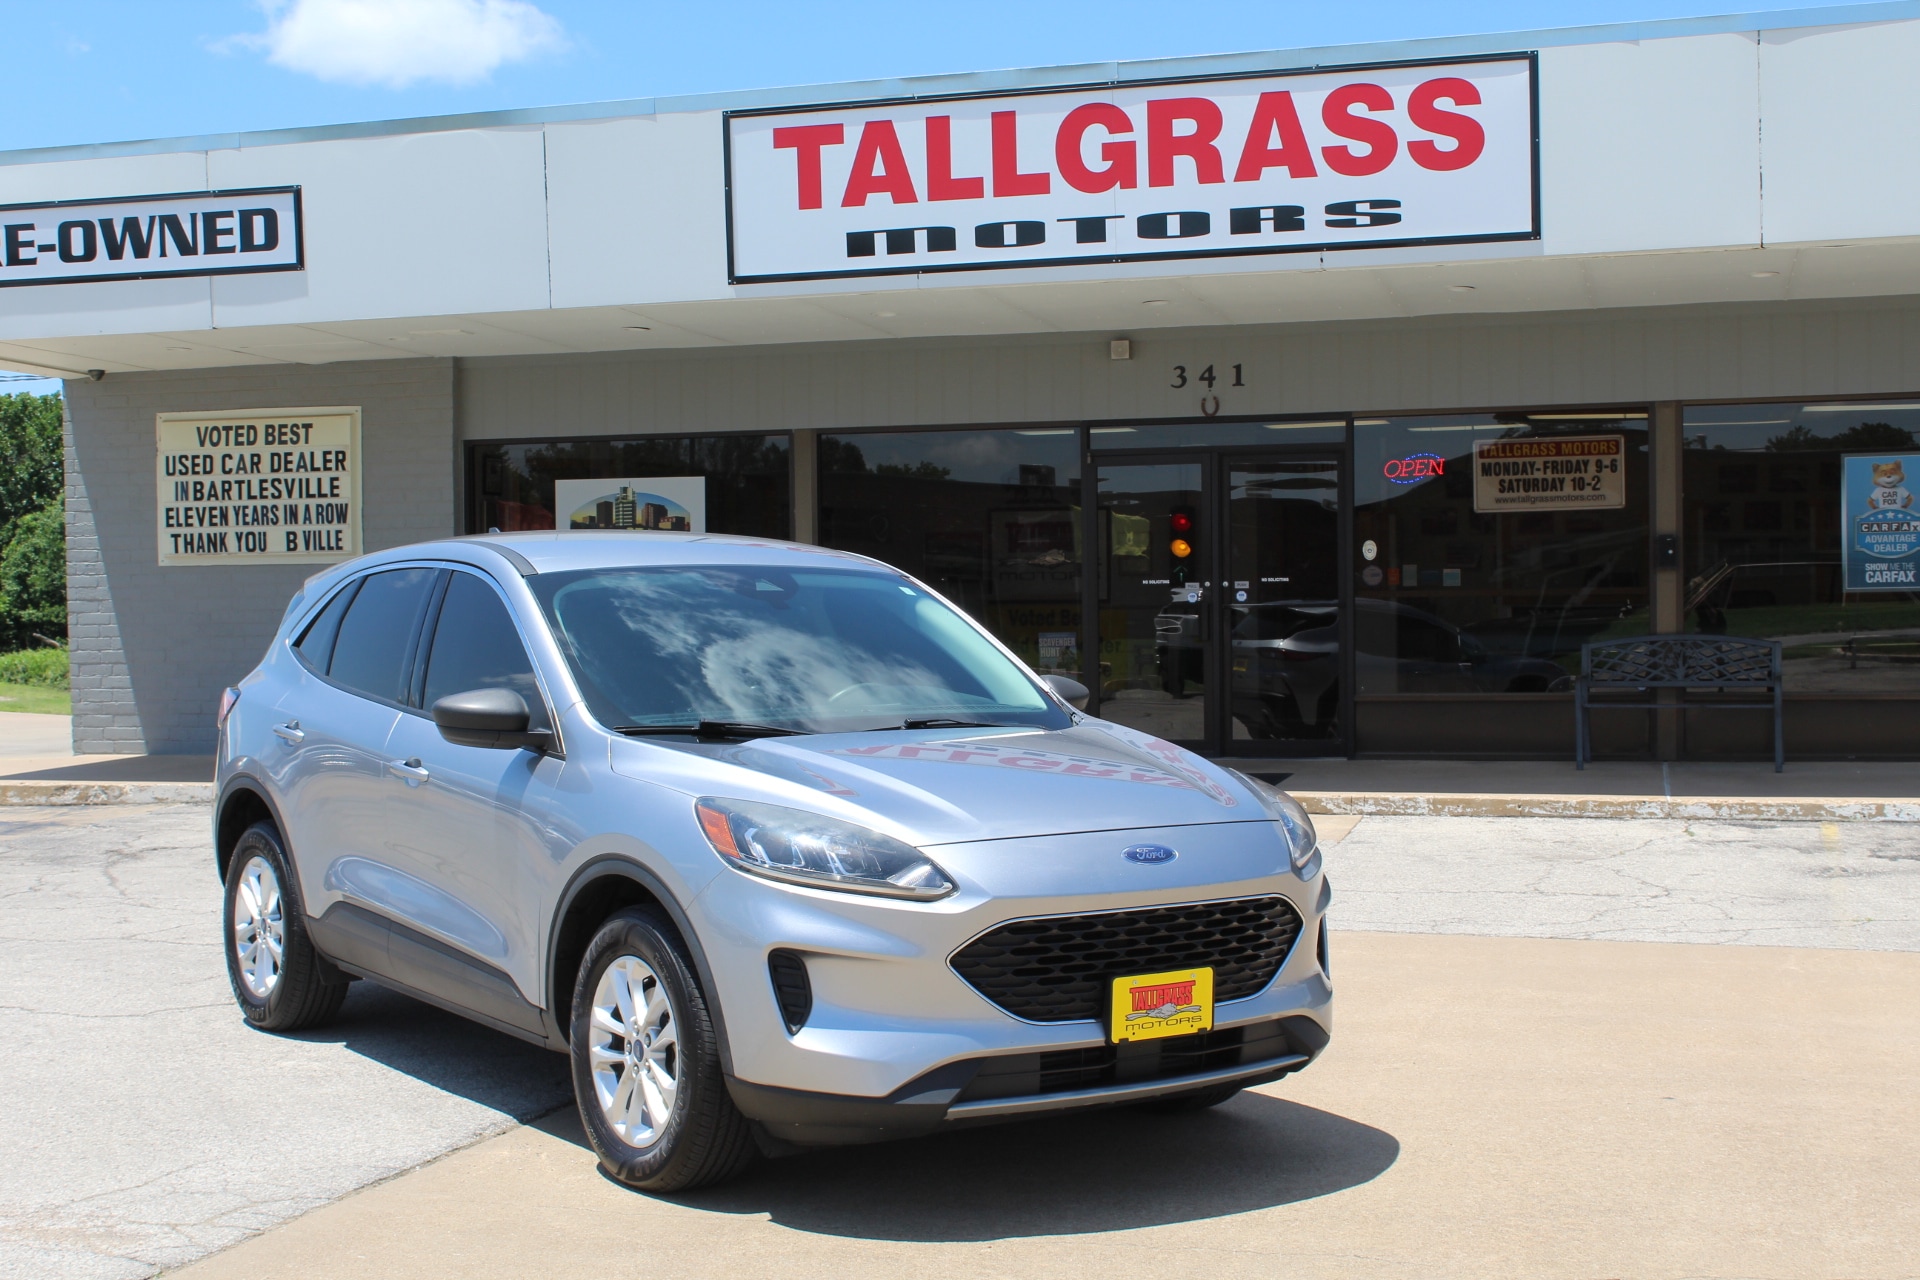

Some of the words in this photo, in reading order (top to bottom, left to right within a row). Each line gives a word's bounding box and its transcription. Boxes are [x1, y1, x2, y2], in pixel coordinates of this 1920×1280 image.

[772, 77, 1485, 211] TALLGRASS
[845, 199, 1402, 258] MOTORS
[0, 208, 279, 267] E-OWNED
[196, 424, 258, 448] VOTED
[264, 422, 313, 446] BEST
[1482, 443, 1557, 457] TALLGRASS
[1561, 441, 1617, 455] MOTORS
[165, 454, 214, 477] USED
[221, 453, 262, 475] CAR
[270, 450, 346, 473] DEALER
[1383, 458, 1446, 478] OPEN
[1481, 459, 1590, 477] MONDAY-FRIDAY
[1595, 459, 1617, 473] 9-6
[1498, 477, 1565, 493] SATURDAY
[1570, 475, 1601, 491] 10-2
[1494, 493, 1606, 504] www.tallgrassmotors.com
[165, 506, 229, 528] ELEVEN
[232, 504, 279, 527] YEARS
[284, 504, 298, 525] IN
[303, 503, 312, 525] A
[316, 503, 348, 525] ROW
[1861, 522, 1920, 532] CARFAX
[170, 532, 228, 554] THANK
[235, 531, 267, 553] YOU
[286, 531, 298, 552] B
[302, 530, 343, 551] VILLE
[1865, 534, 1917, 543] ADVANTAGE
[1873, 543, 1908, 552] DEALER
[1865, 563, 1888, 571] SHOW
[1902, 562, 1915, 570] THE
[1865, 570, 1916, 583] CARFAX
[1038, 637, 1076, 647] SCAVENGER
[1039, 647, 1060, 658] HUNT
[1136, 847, 1166, 860] Ford
[1129, 980, 1196, 1012] TALLGRASS
[1125, 1015, 1203, 1032] MOTORS
